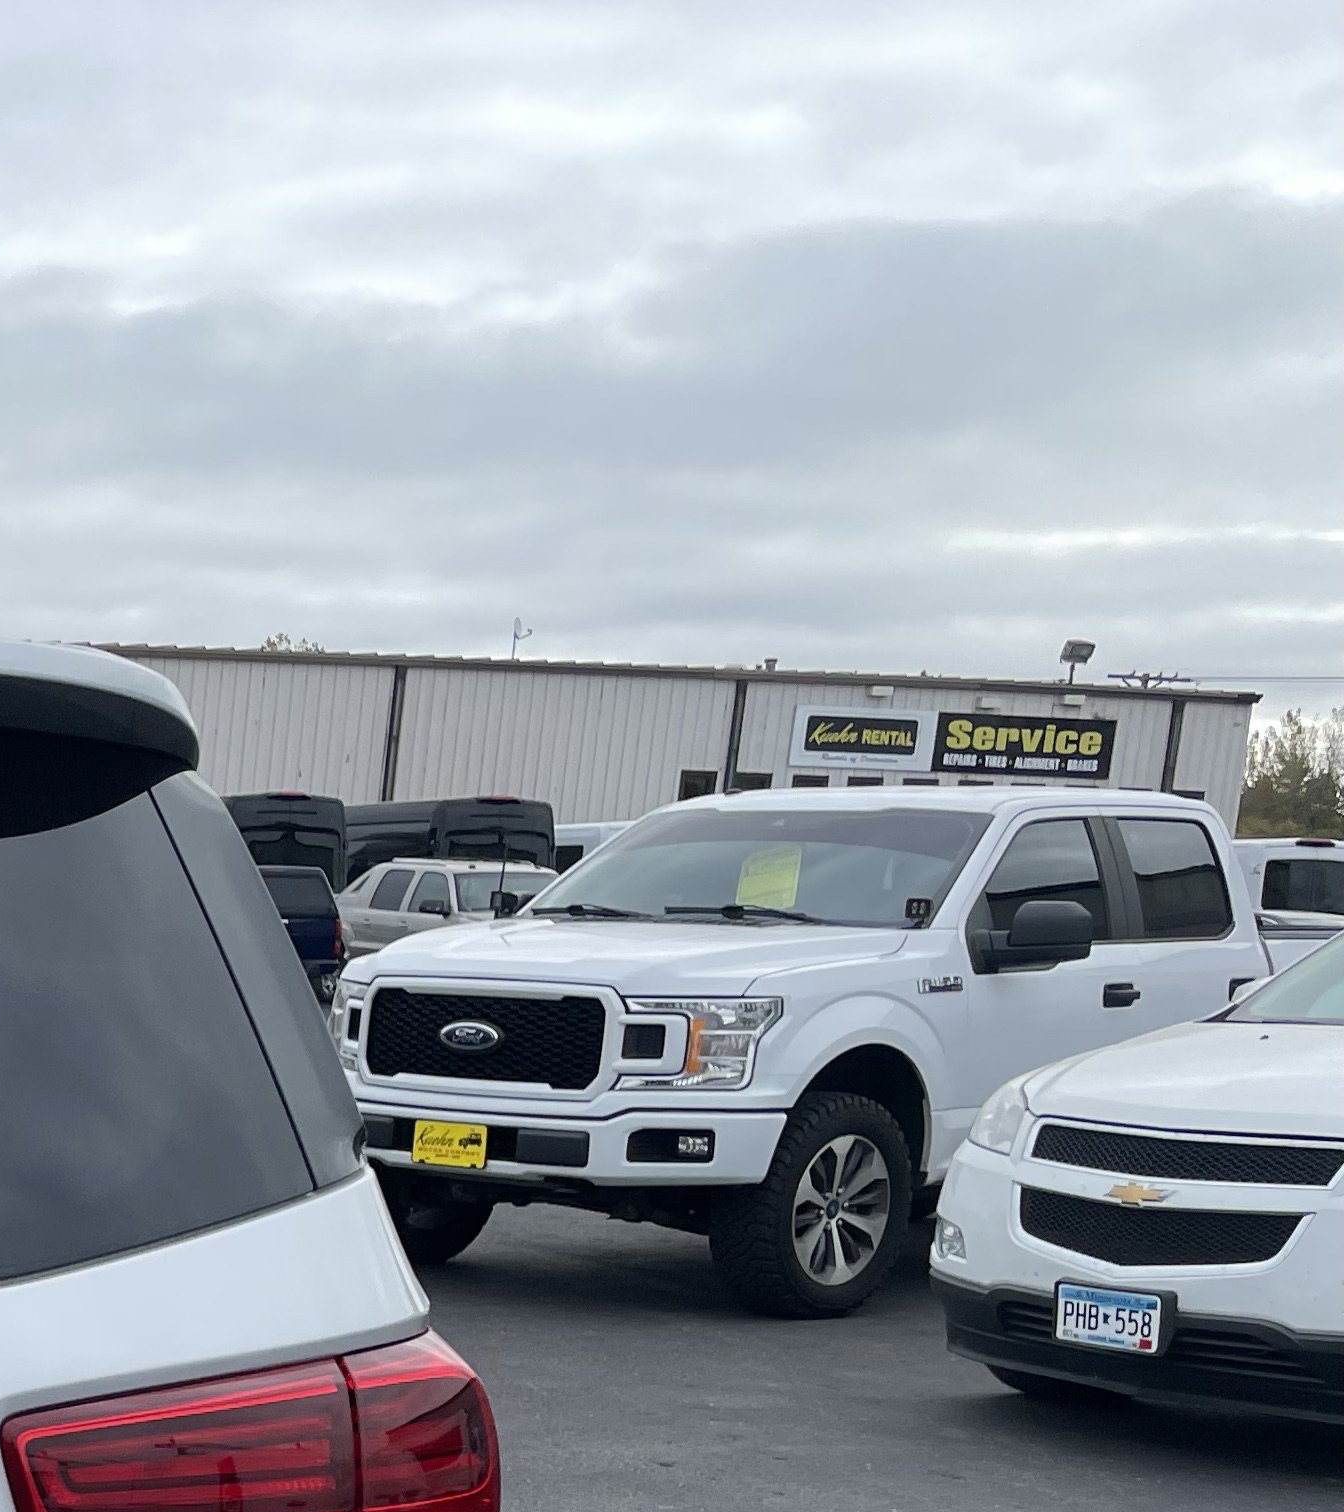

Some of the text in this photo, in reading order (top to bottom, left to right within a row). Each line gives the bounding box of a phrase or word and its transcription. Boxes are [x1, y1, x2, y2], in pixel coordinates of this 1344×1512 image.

[809, 721, 914, 747] Kuehn RENTAL
[945, 718, 1103, 756] Service
[1063, 1300, 1152, 1338] PHB 558
